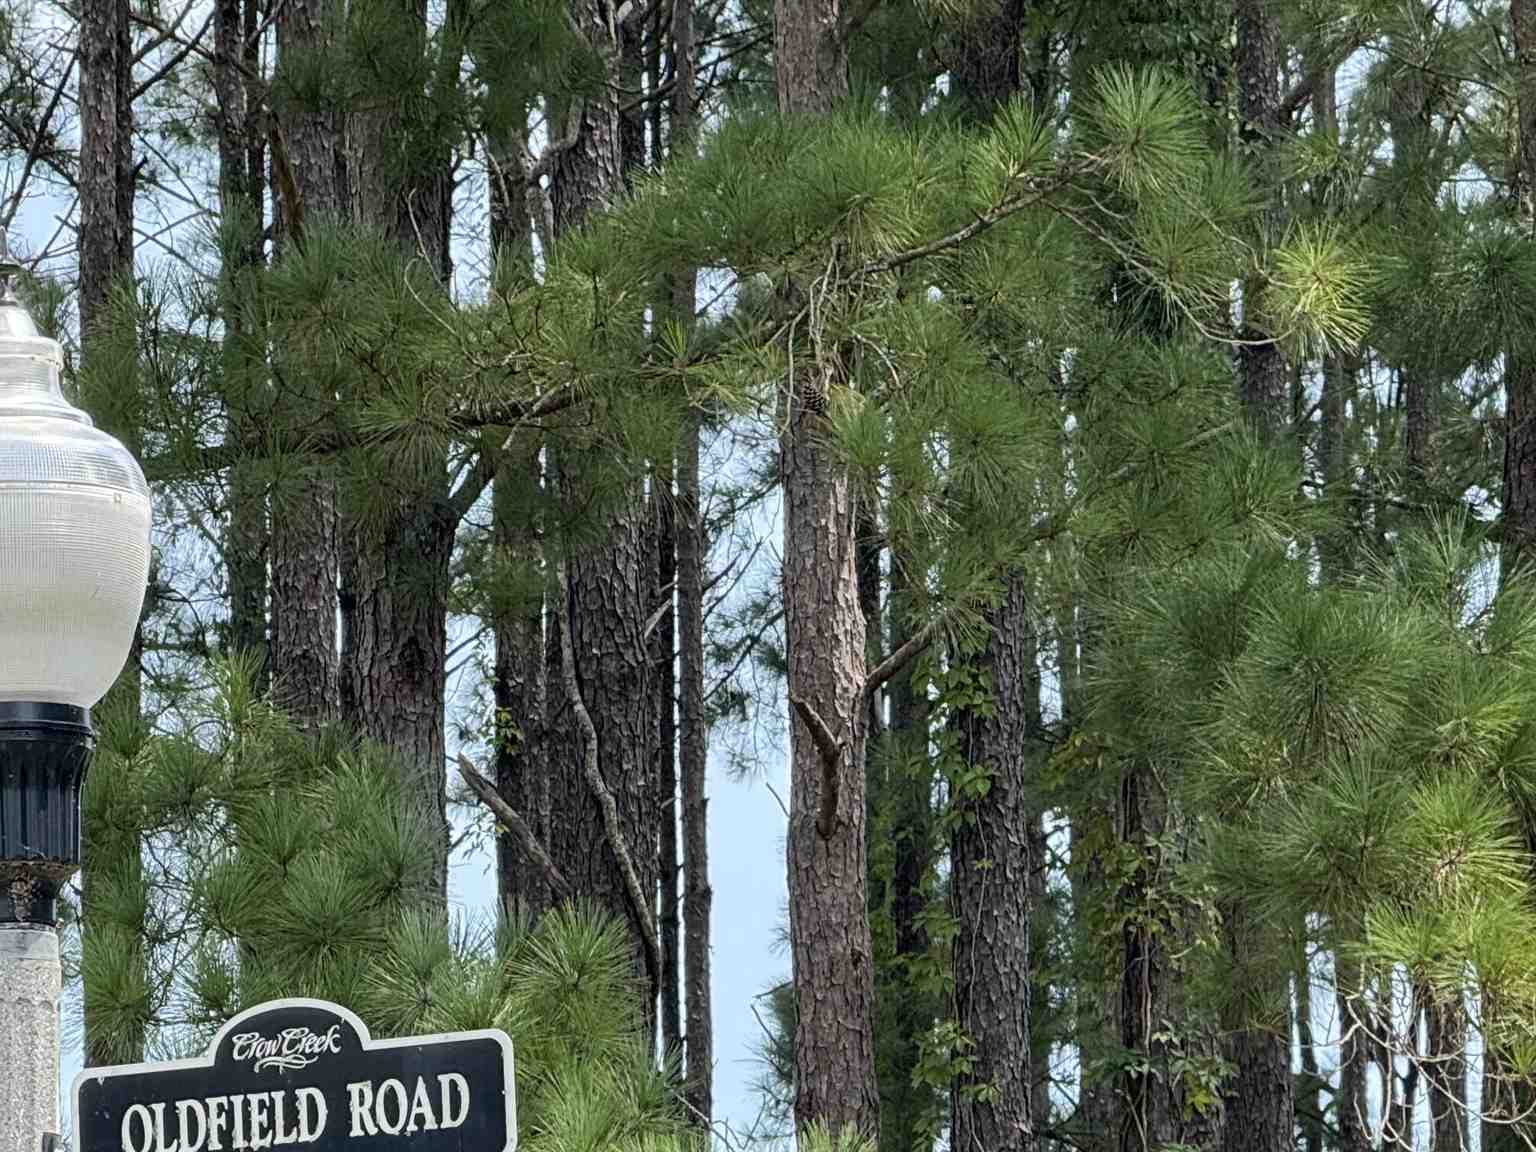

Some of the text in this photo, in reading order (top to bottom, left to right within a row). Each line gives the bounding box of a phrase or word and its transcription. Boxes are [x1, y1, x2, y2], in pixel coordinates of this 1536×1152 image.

[231, 1024, 342, 1060] Crow Creek
[346, 1072, 470, 1137] ROAD
